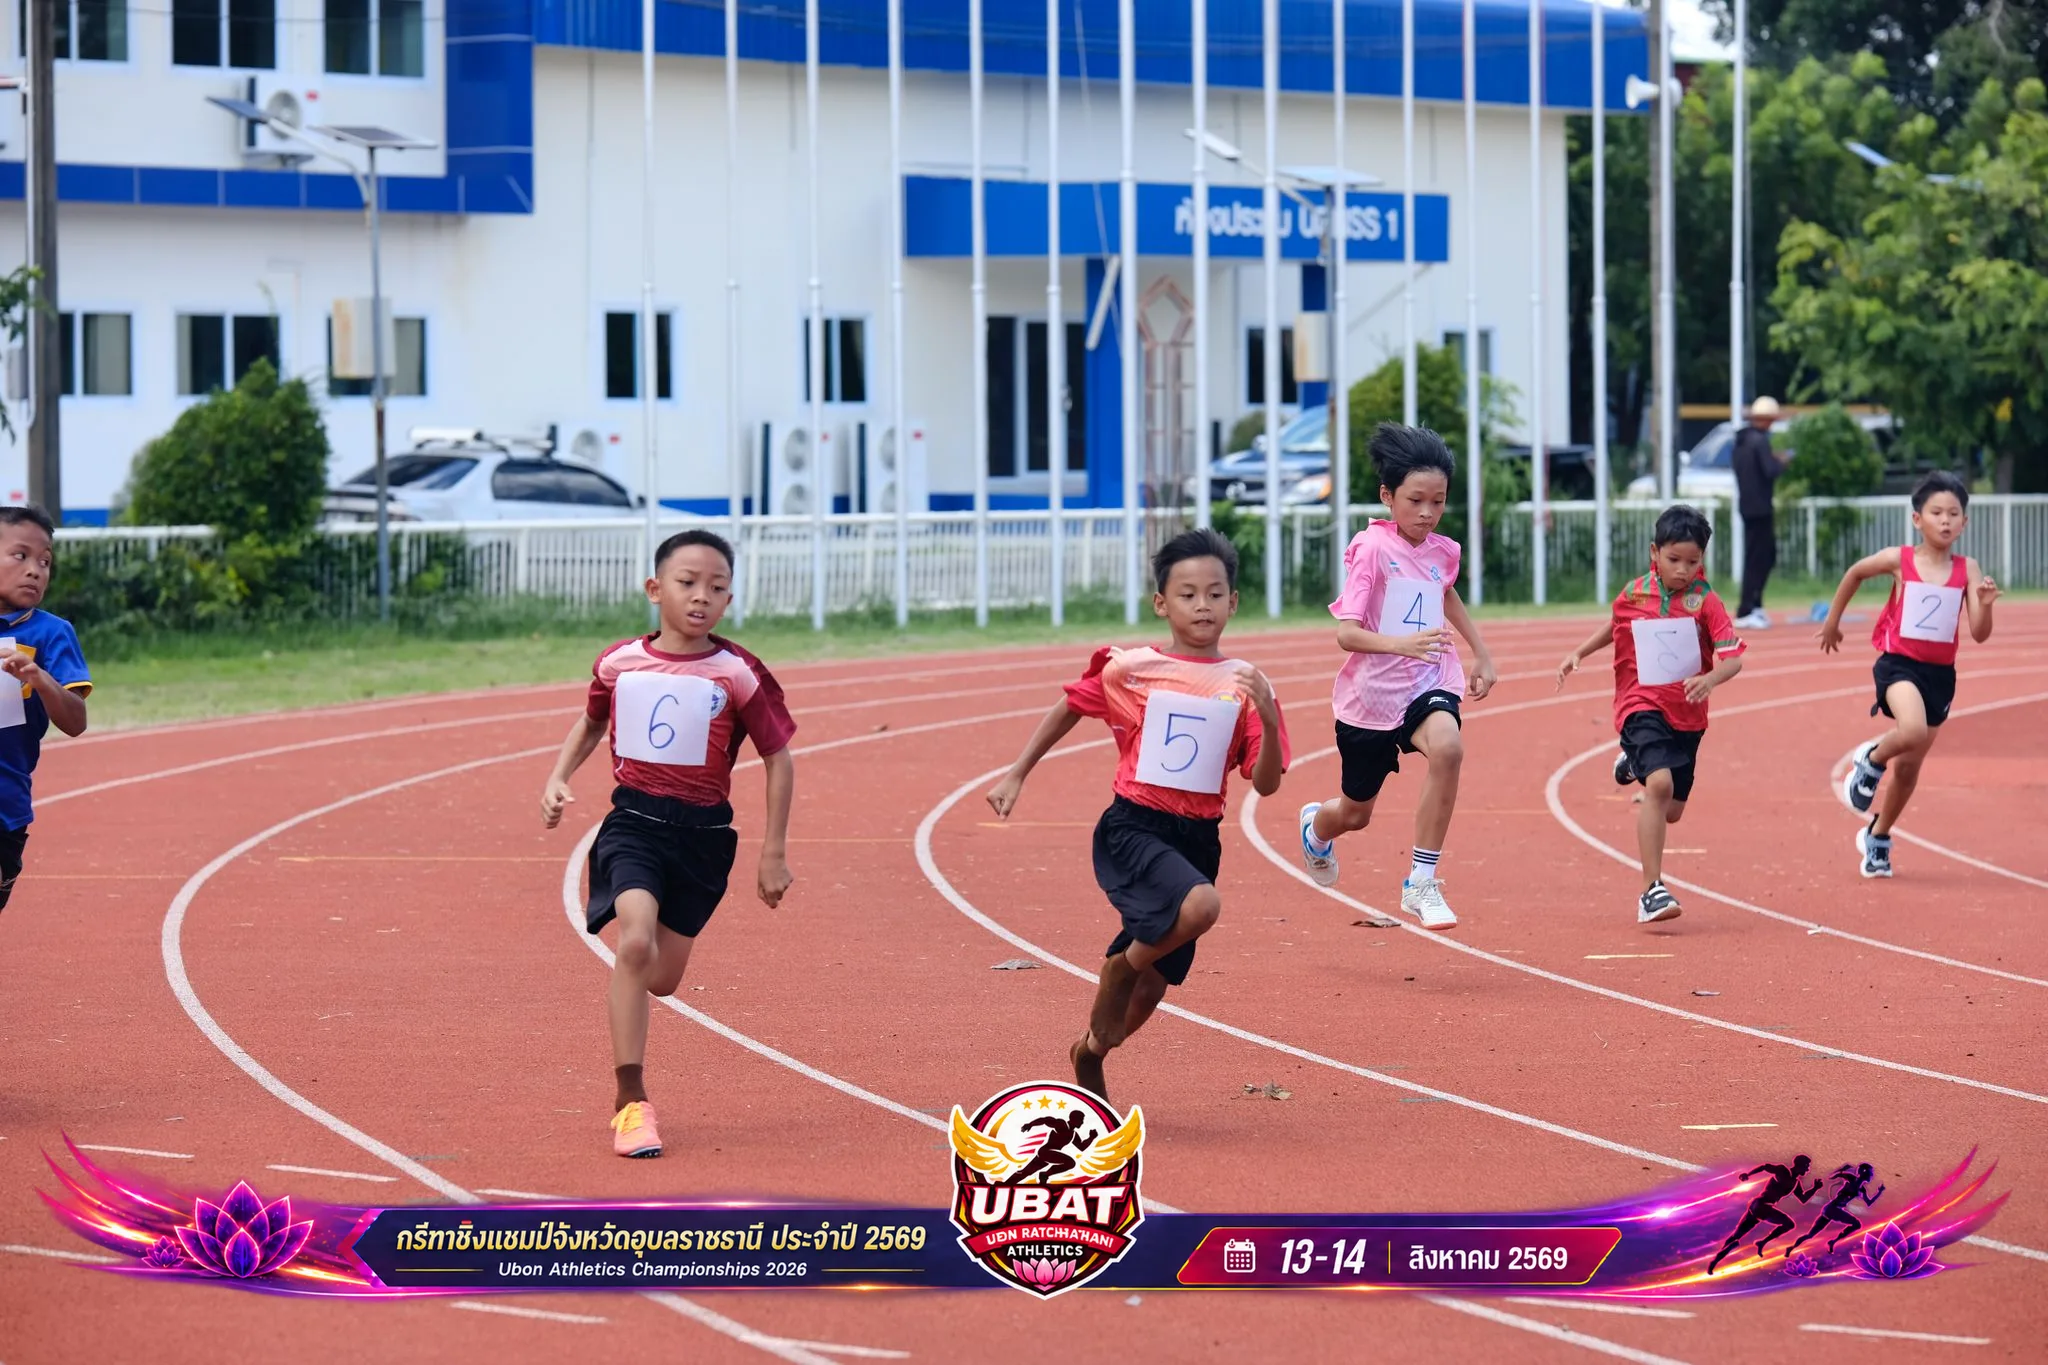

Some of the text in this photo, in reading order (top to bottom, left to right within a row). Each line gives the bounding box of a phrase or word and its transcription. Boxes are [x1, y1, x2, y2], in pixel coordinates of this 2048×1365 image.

[1385, 208, 1398, 242] 1
[1402, 592, 1427, 633] 4
[1915, 594, 1942, 630] 2
[649, 694, 680, 749] 6
[1161, 713, 1207, 772] 5
